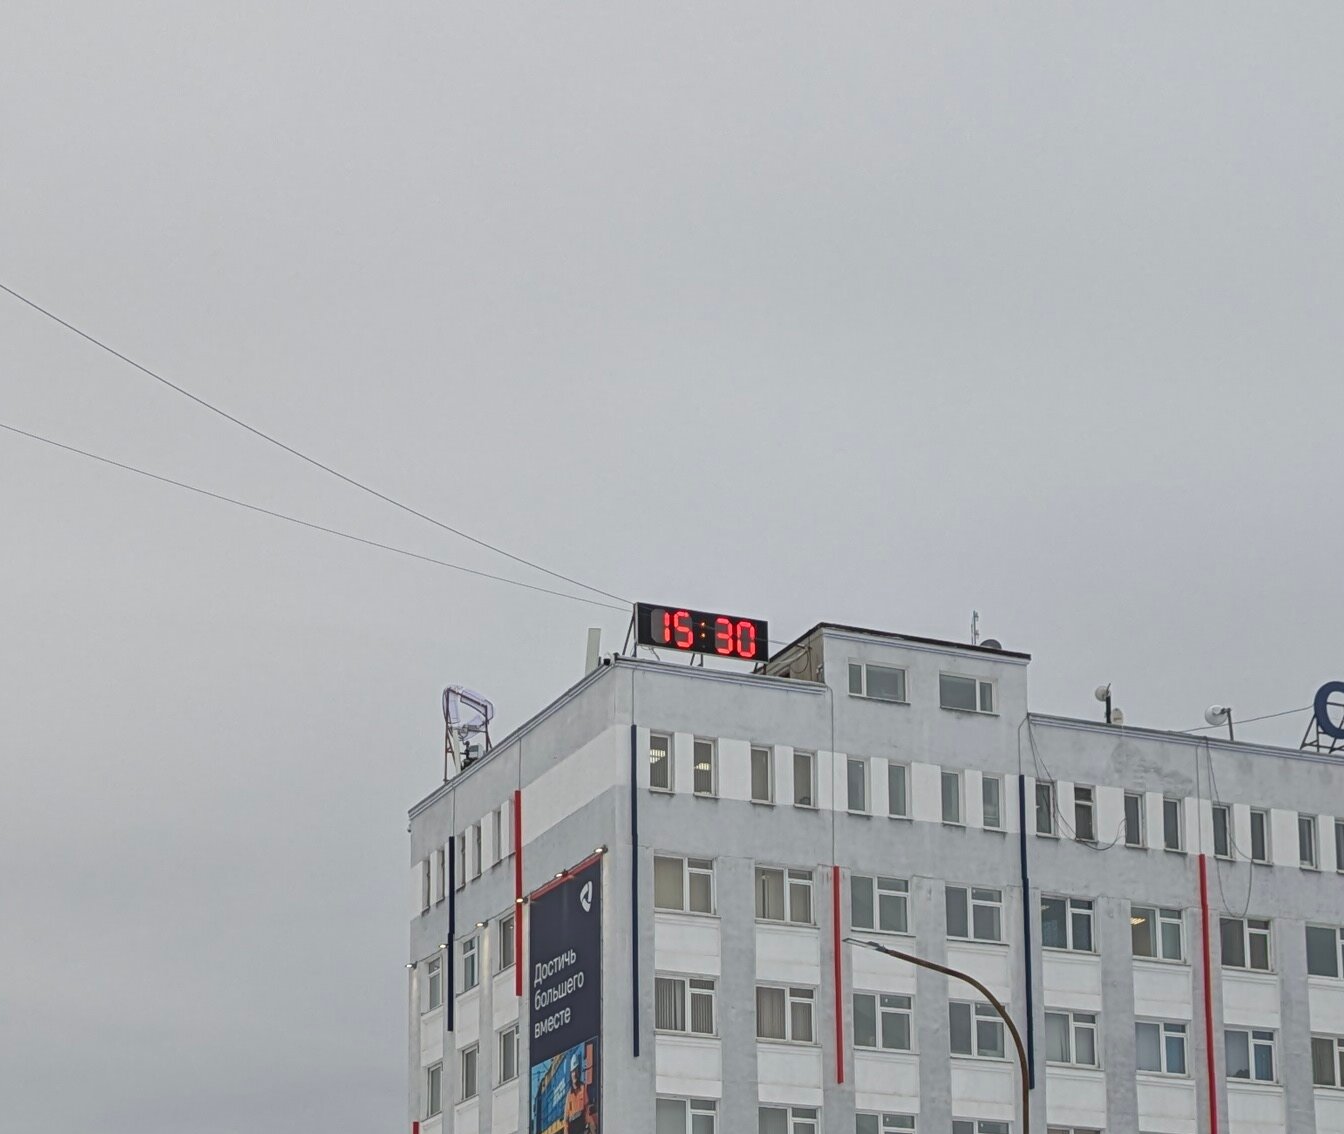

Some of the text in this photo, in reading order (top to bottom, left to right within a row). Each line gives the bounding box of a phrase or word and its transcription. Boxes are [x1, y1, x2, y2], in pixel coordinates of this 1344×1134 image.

[664, 611, 756, 658] 15:30
[534, 949, 577, 988] Достичь
[534, 971, 584, 1011] большего
[534, 1007, 571, 1039] вместе
